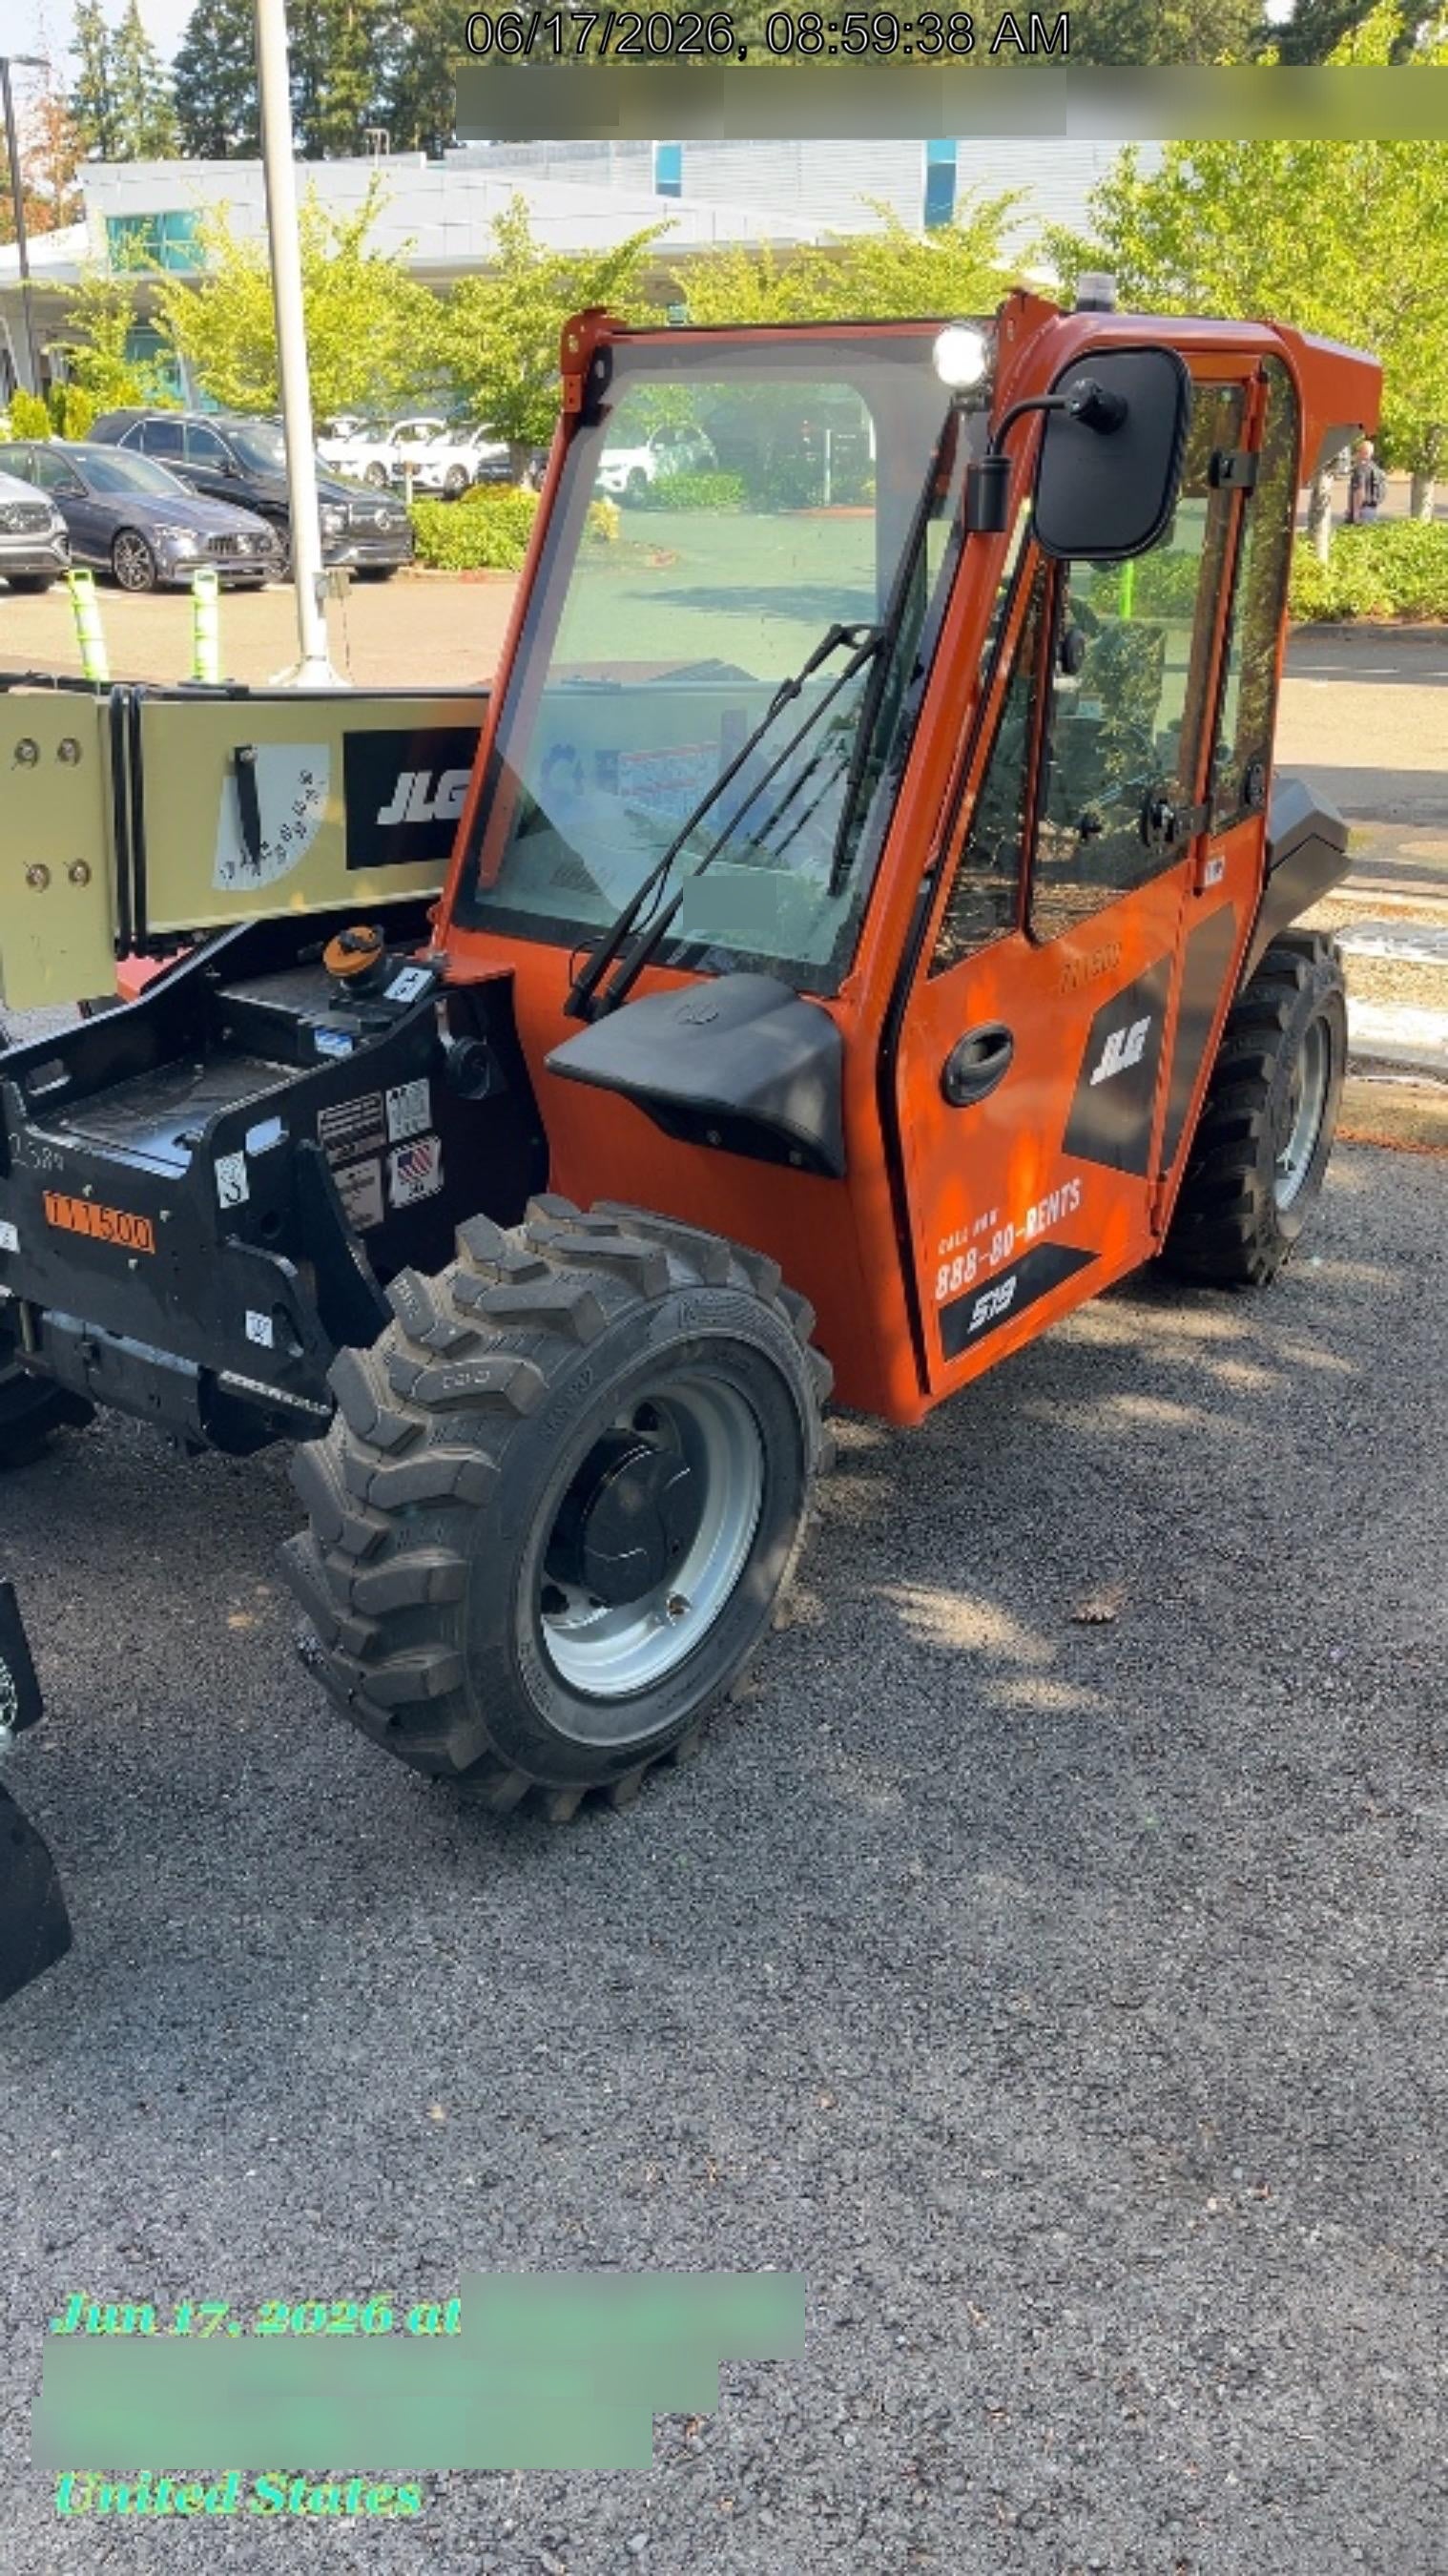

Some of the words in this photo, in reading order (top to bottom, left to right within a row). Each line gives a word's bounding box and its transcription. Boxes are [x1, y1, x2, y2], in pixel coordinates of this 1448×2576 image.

[376, 769, 473, 826] JLG
[1089, 1014, 1152, 1087] JLG
[50, 1195, 151, 1249] 111500
[935, 1176, 1082, 1300] 888-80-RENTS
[938, 1226, 969, 1257] CALL
